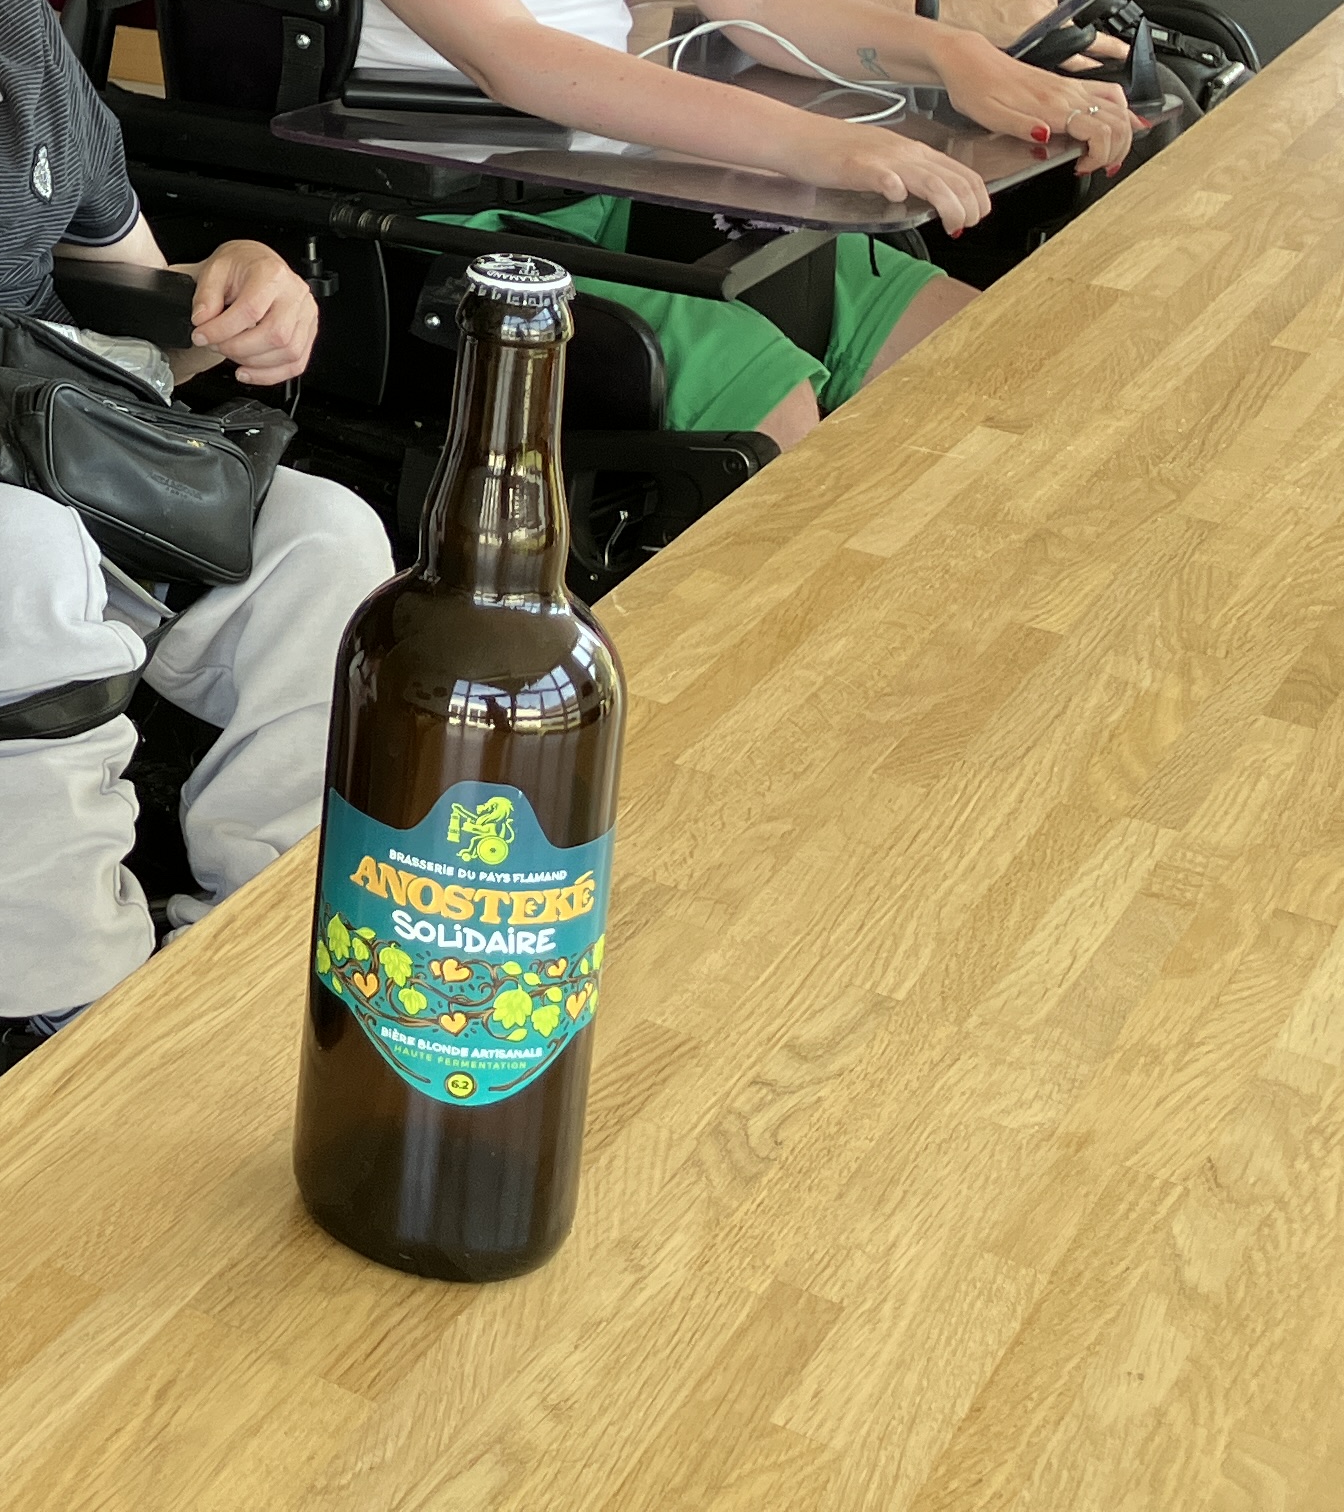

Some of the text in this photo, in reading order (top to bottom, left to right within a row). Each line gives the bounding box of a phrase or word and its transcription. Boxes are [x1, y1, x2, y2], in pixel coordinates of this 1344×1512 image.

[457, 867, 476, 880] DU
[479, 871, 511, 884] PAYS
[512, 870, 568, 884] FLAMAND
[350, 854, 596, 925] ANOSTEKÉ
[394, 1044, 527, 1070] HAUTE FERMENTATION
[417, 1038, 469, 1058] BLONDE
[471, 1047, 543, 1059] ARTISANALE
[451, 1079, 470, 1090] 6.2
